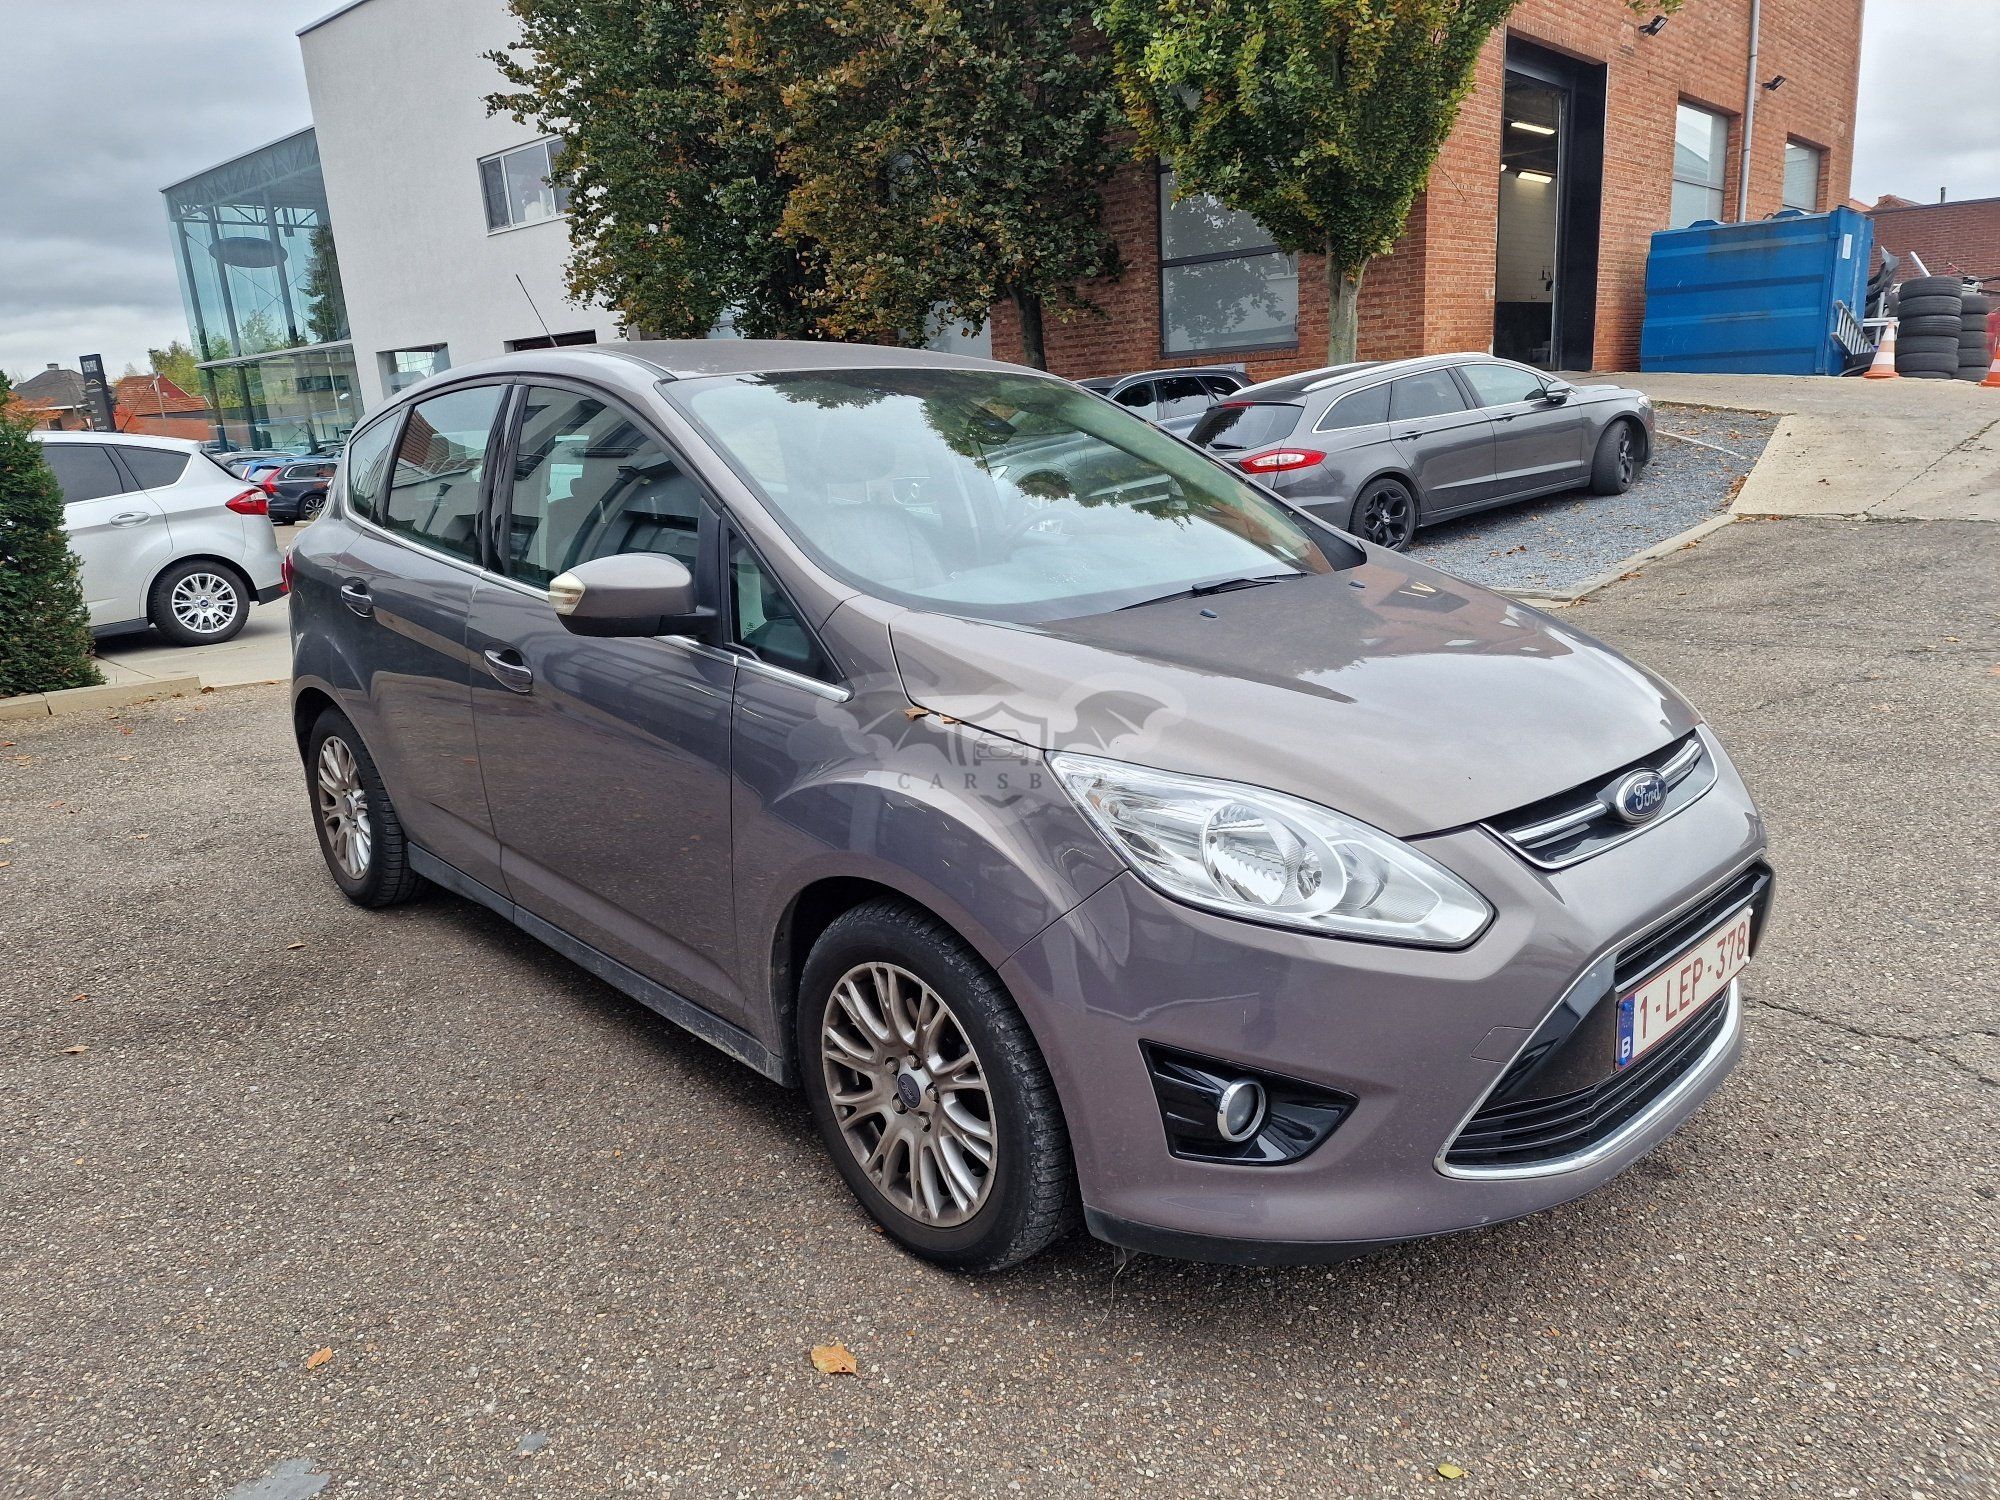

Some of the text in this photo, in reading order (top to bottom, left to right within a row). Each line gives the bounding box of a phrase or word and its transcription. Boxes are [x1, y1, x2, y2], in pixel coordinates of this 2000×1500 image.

[1634, 780, 1661, 811] Ford
[1639, 921, 1746, 1039] 1-LEP-378
[1621, 1036, 1631, 1058] B
